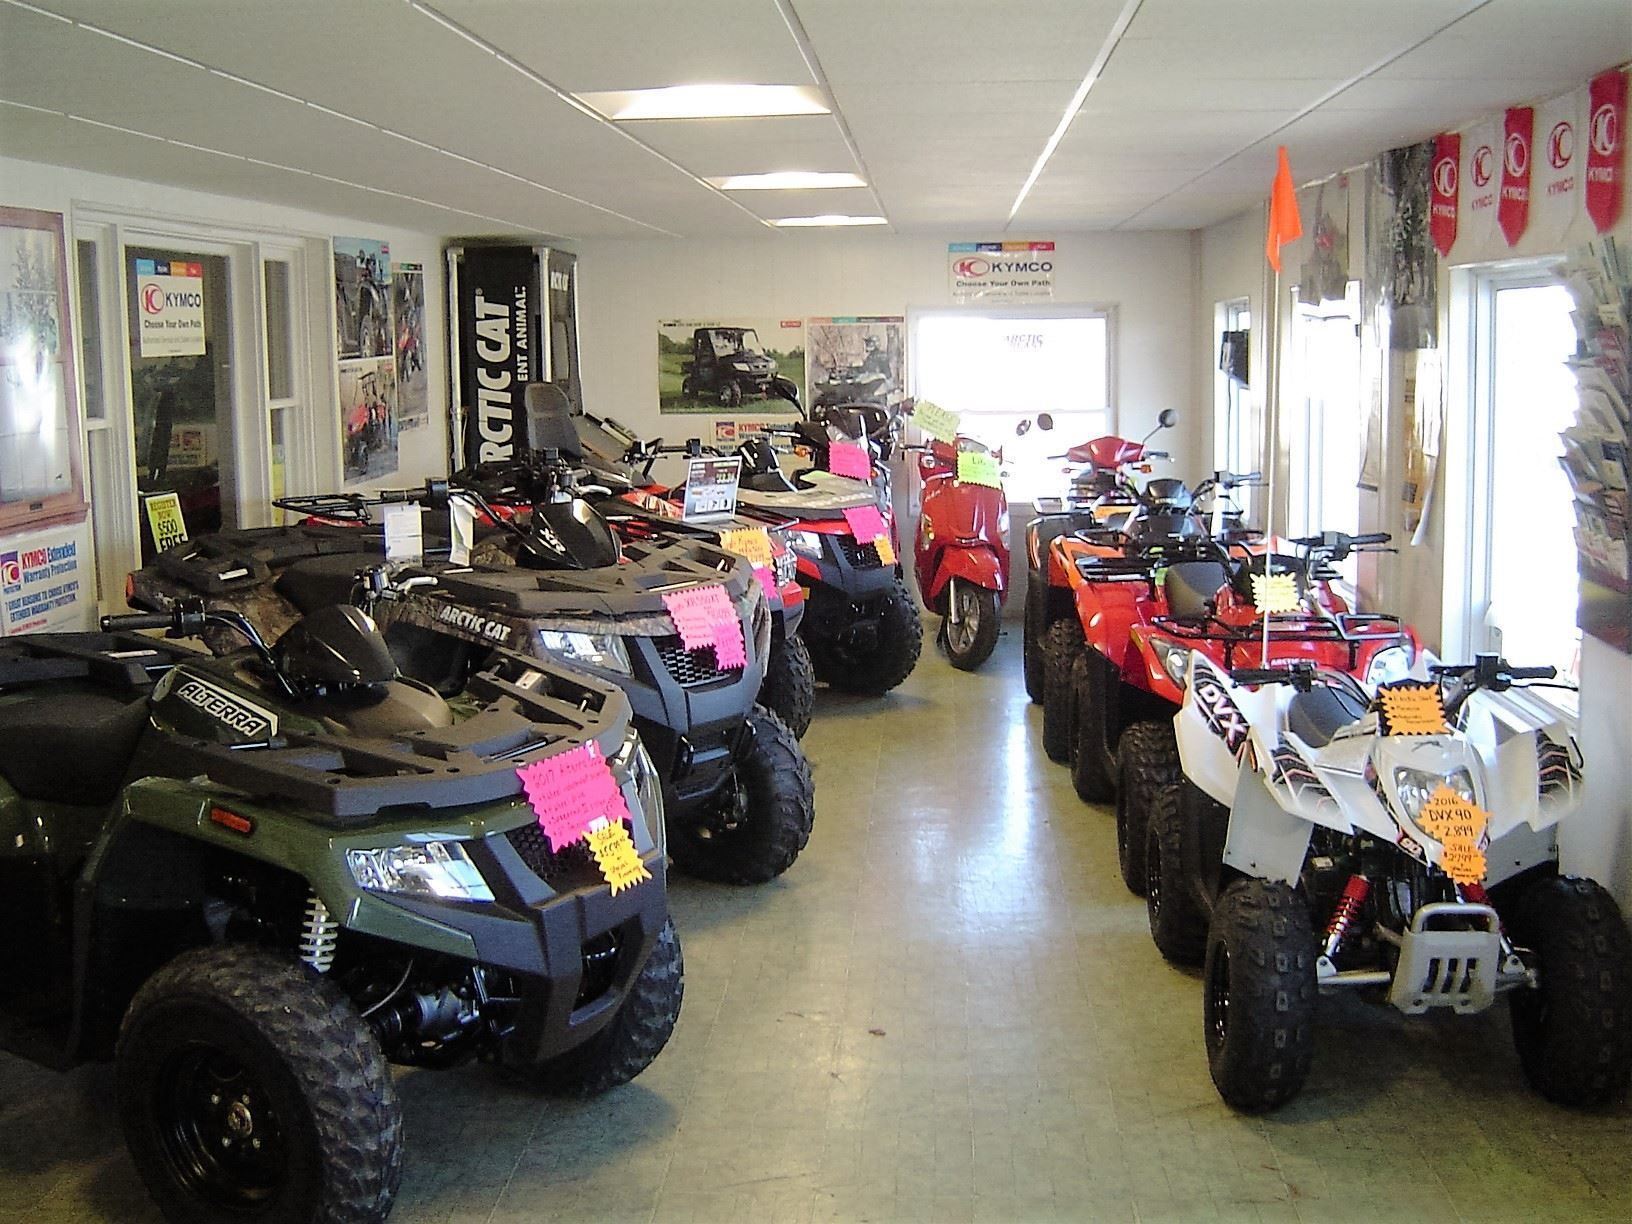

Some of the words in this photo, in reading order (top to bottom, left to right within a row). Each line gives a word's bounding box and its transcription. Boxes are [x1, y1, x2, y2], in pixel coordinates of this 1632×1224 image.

[1547, 177, 1574, 197] KYMCO
[1471, 194, 1493, 211] KYMCO
[991, 262, 1053, 272] KYMCO
[956, 280, 987, 288] Choose
[990, 280, 1008, 288] Your
[165, 292, 201, 308] KYMCO
[144, 319, 164, 329] Choose
[165, 319, 178, 329] Your
[178, 320, 190, 329] Own
[476, 368, 514, 464] RCTIC
[21, 547, 47, 570] KYMCO
[47, 540, 76, 563] Extended
[23, 567, 51, 584] Warranty
[50, 560, 77, 576] Protection
[440, 605, 486, 633] ARCTIC
[484, 621, 512, 641] CAT
[177, 681, 268, 737] ALTERRA
[1198, 683, 1248, 746] DVX
[1434, 797, 1459, 806] 2016
[1428, 809, 1454, 821] DVX
[1455, 808, 1472, 821] 90
